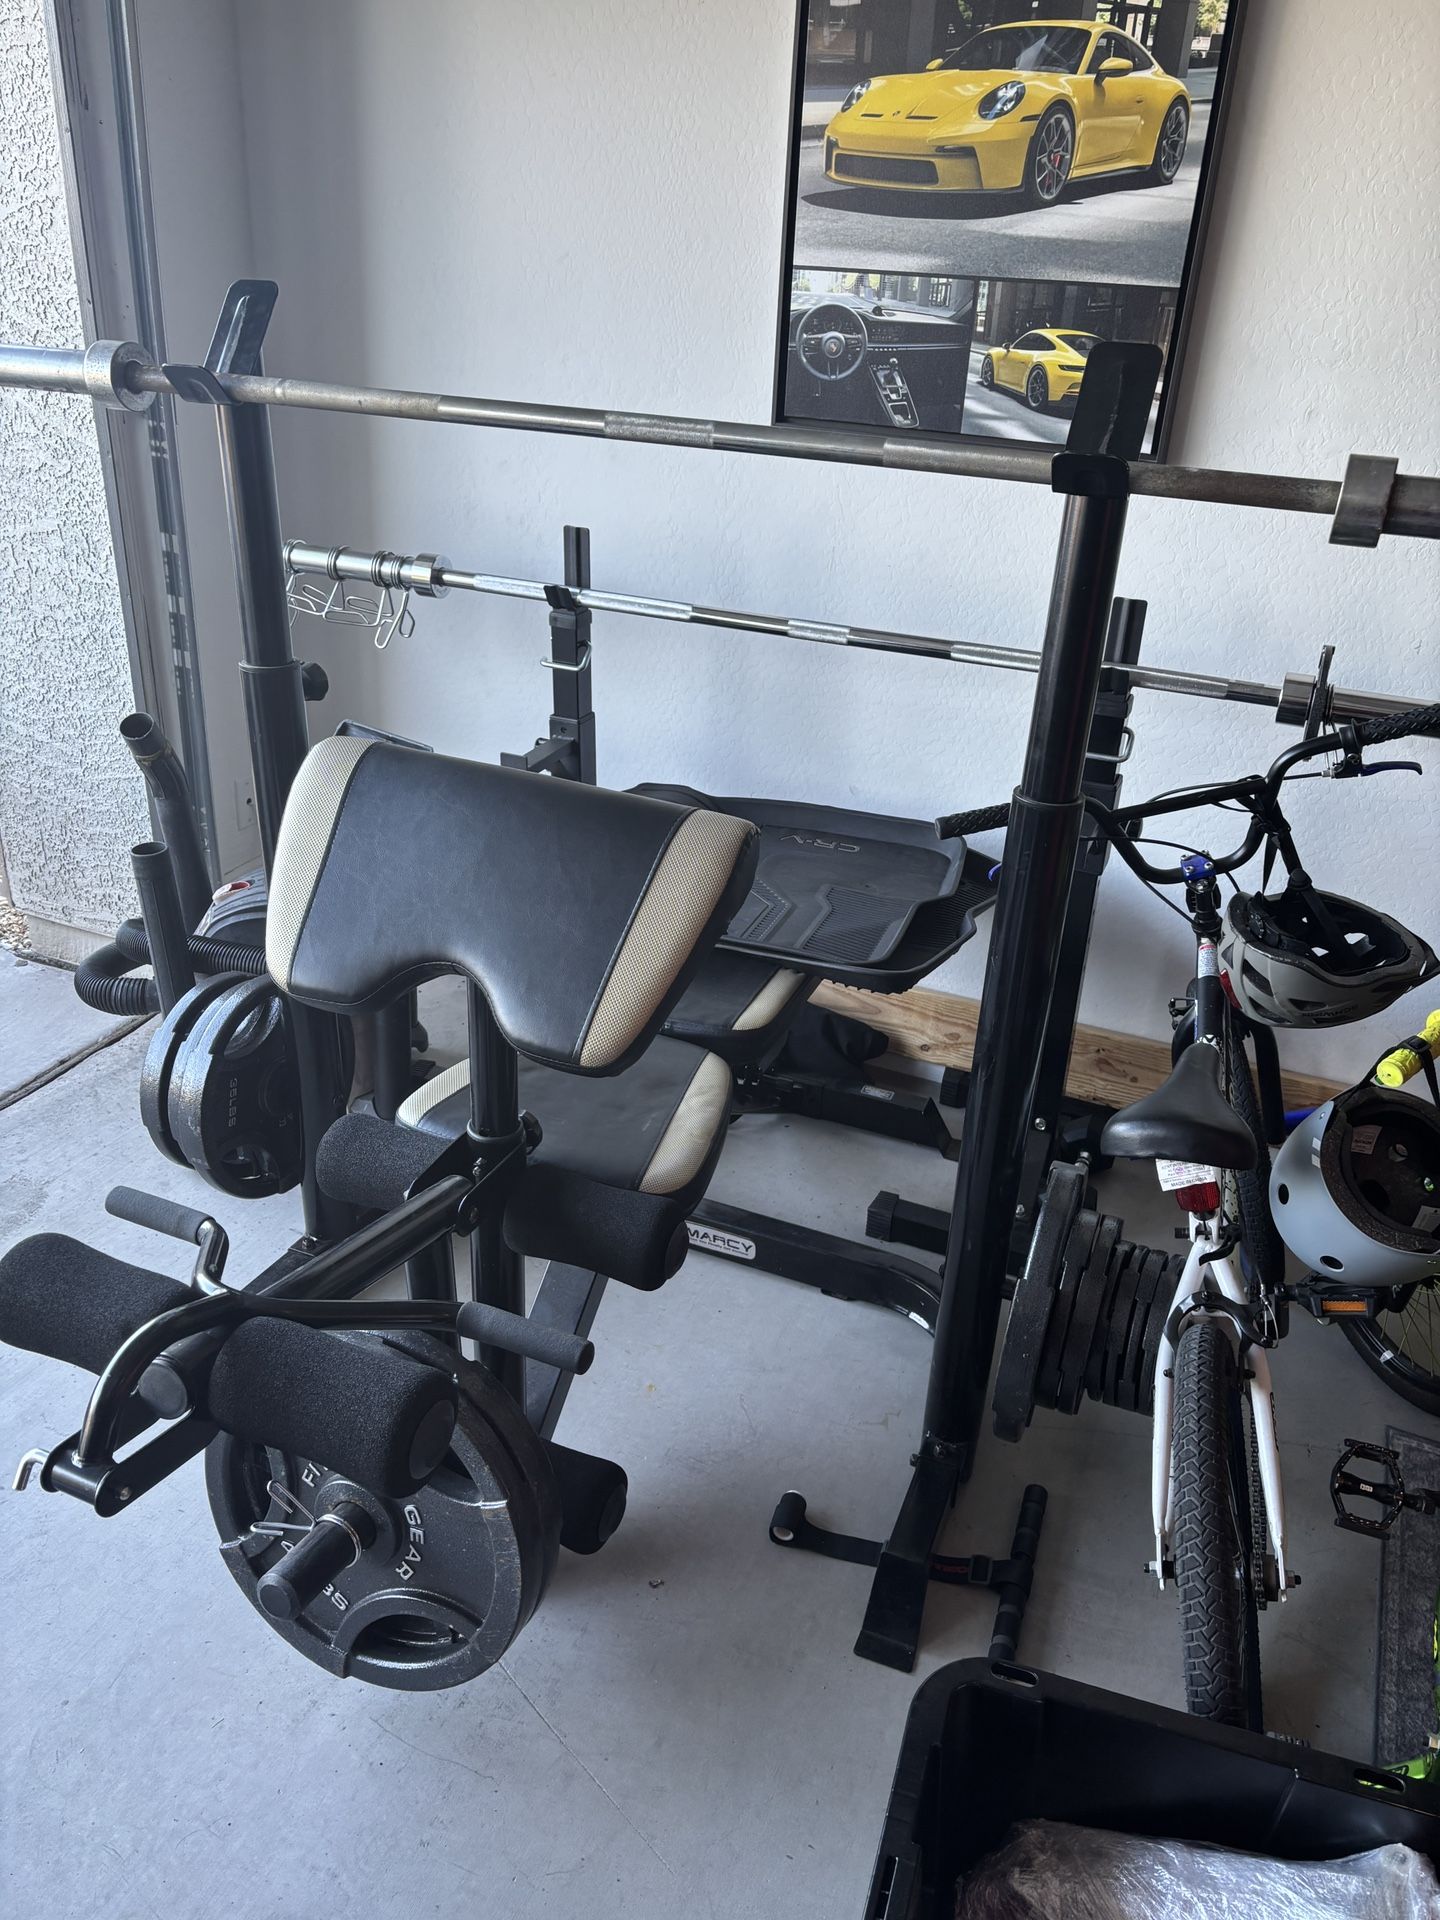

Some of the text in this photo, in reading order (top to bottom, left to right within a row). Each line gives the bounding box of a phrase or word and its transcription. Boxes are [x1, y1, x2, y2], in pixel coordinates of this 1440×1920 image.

[780, 834, 861, 853] CR-V
[687, 1228, 753, 1252] MARCY
[395, 1504, 424, 1581] GEAR
